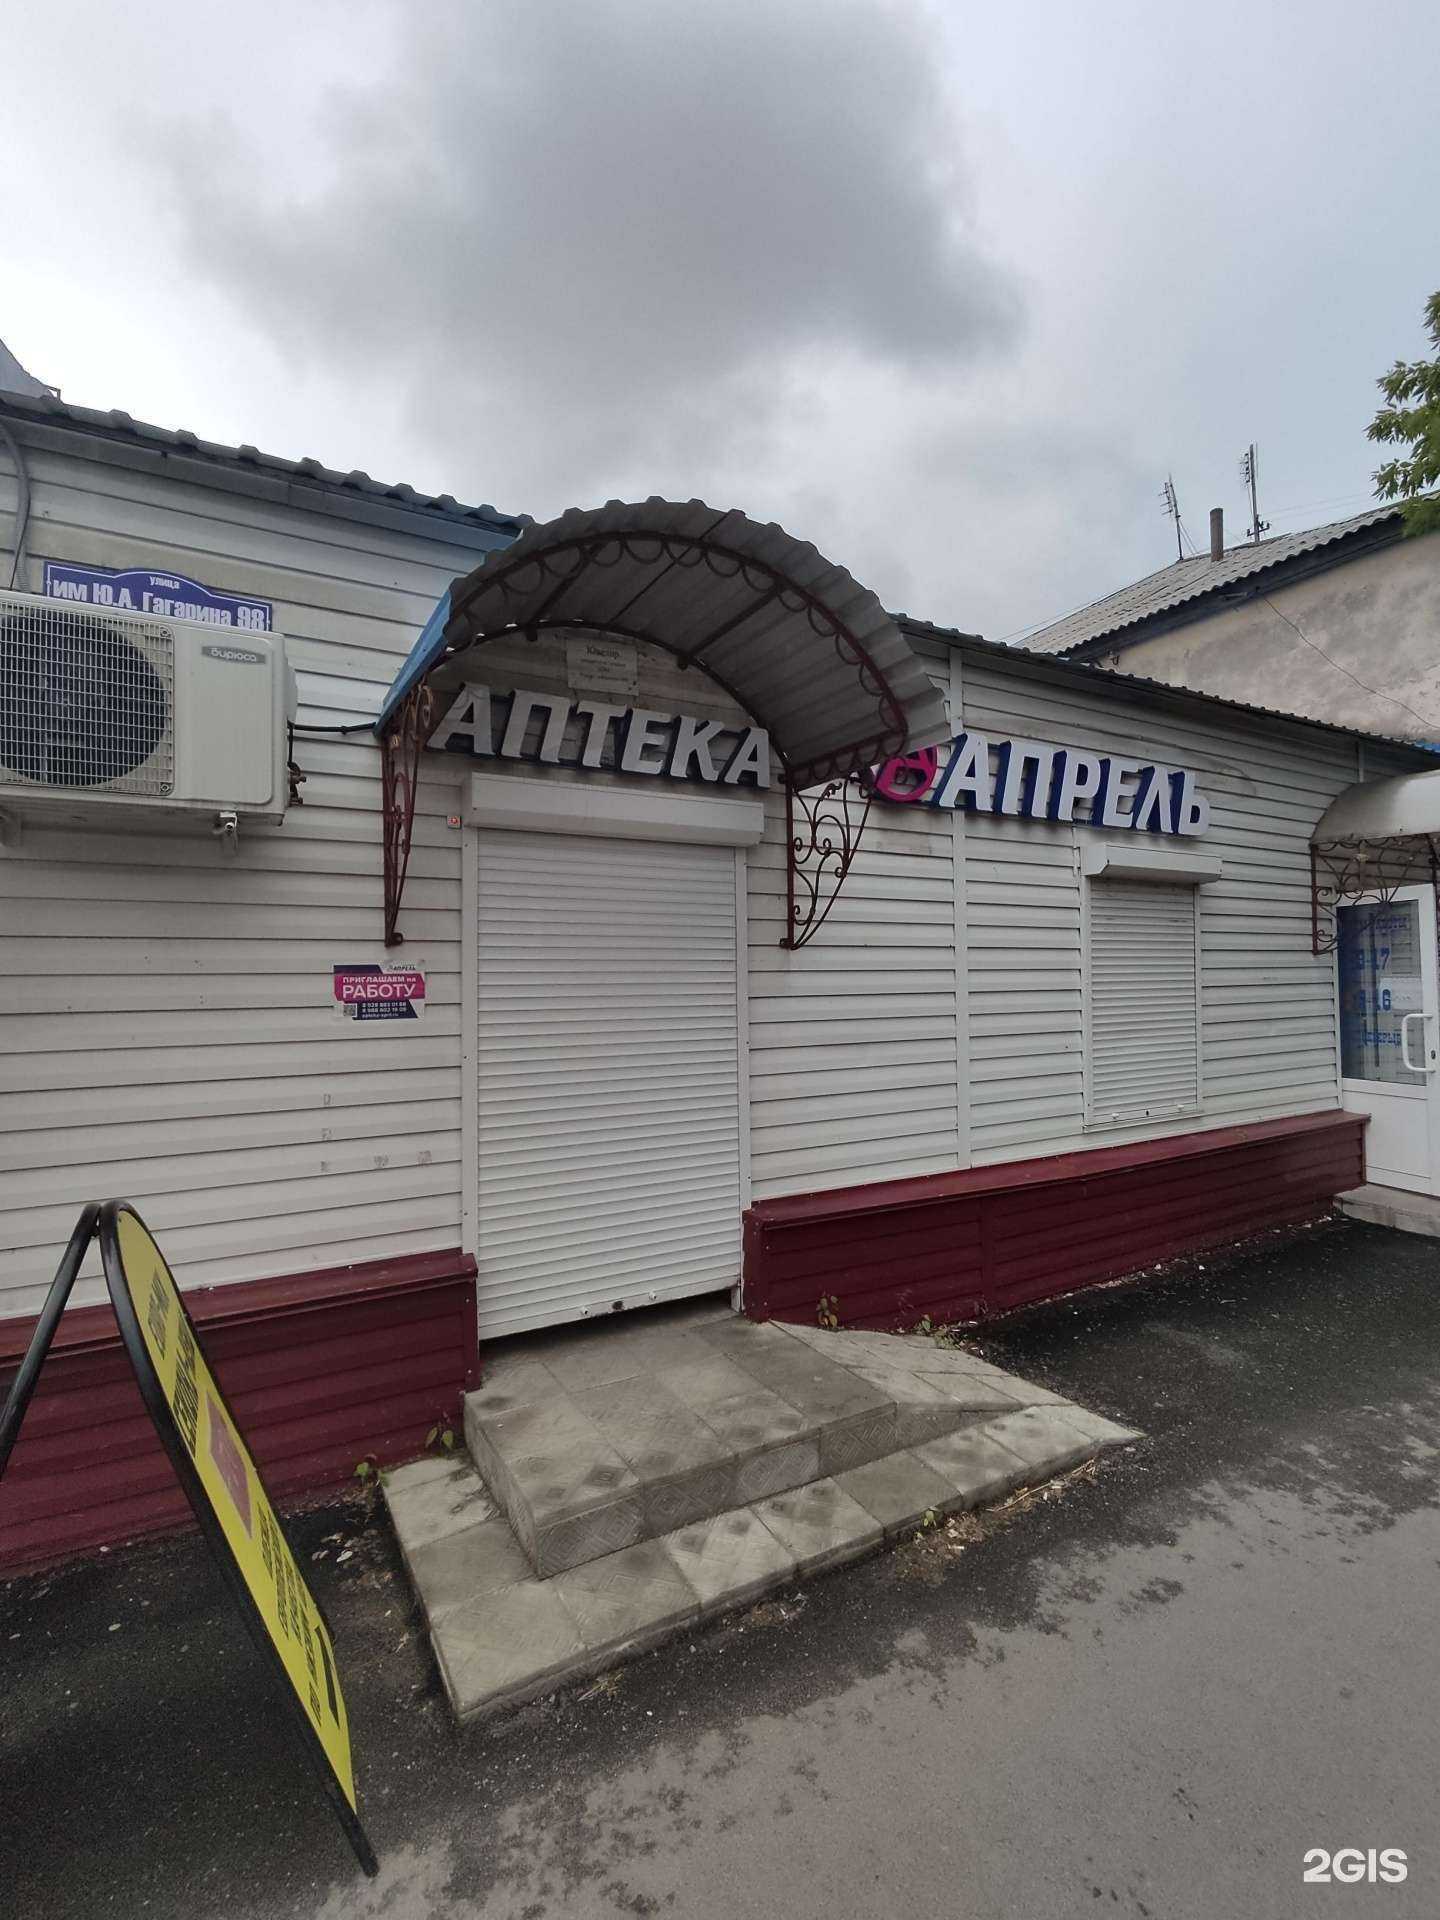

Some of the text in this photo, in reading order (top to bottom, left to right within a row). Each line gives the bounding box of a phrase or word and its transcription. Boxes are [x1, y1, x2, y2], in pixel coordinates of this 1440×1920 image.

[150, 575, 180, 590] улица
[53, 579, 266, 631] им Ю.А. Гагарина 98
[426, 681, 771, 788] АПТЕКА
[936, 730, 1210, 836] АПРЕЛЬ
[342, 976, 405, 984] ПРИГЛАШАЕМ
[342, 983, 417, 998] РАБОТУ
